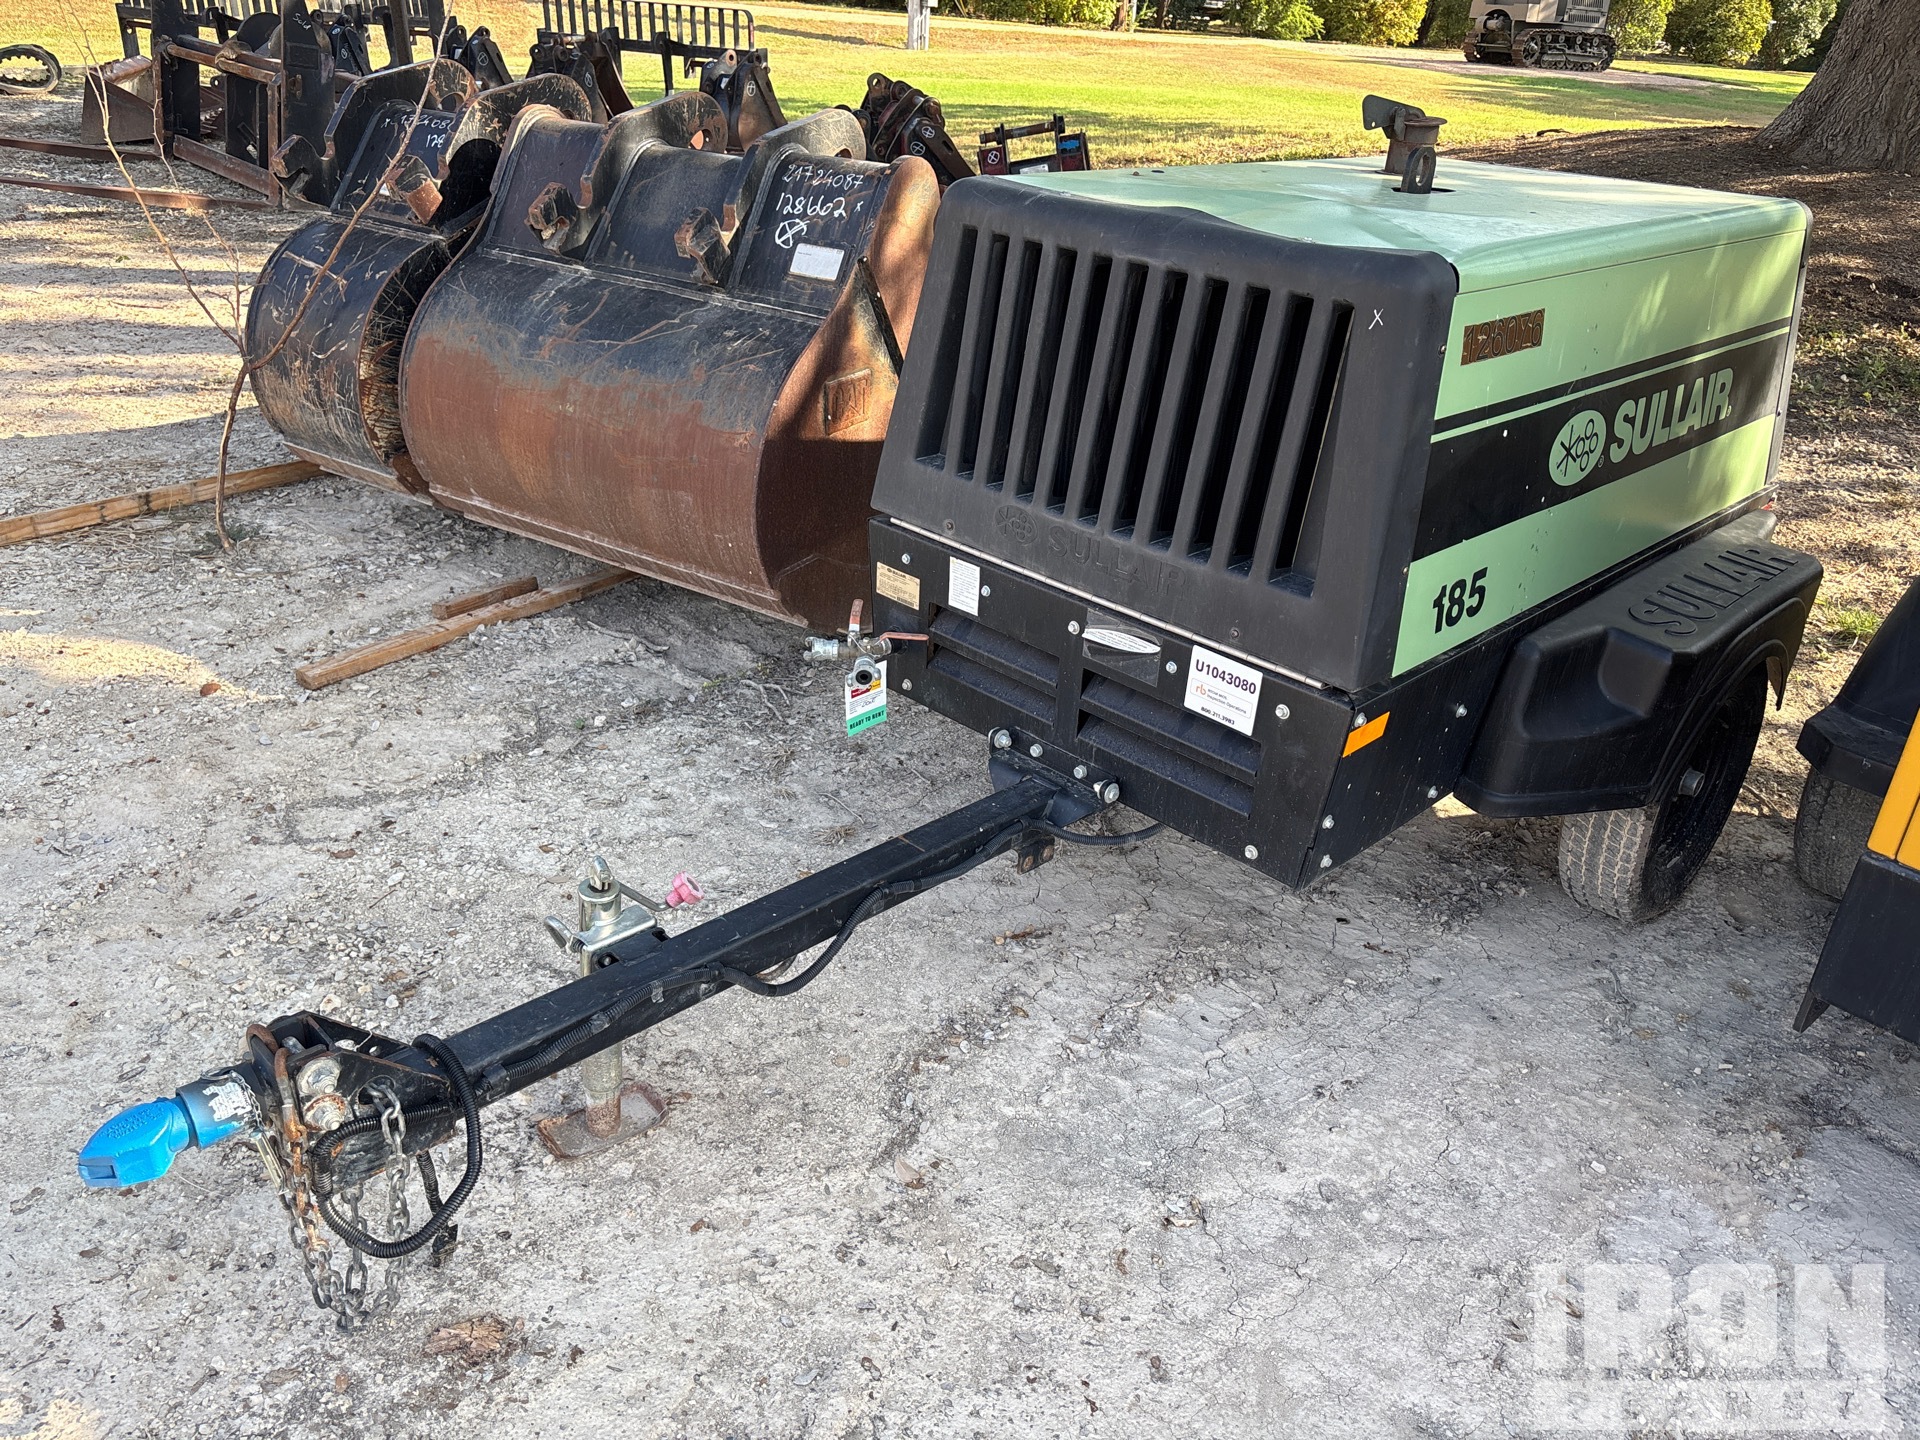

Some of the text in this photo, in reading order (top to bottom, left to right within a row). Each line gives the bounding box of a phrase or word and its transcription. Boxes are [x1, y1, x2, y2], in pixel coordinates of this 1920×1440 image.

[1609, 367, 1734, 464] SULLAIR
[1049, 524, 1187, 600] SULLAIR
[1627, 548, 1799, 637] SULLAIR
[1432, 566, 1489, 634] 185
[1195, 658, 1257, 695] U1043080
[849, 709, 885, 730] READY TO RENT
[1200, 706, 1235, 725] 800.211.3983
